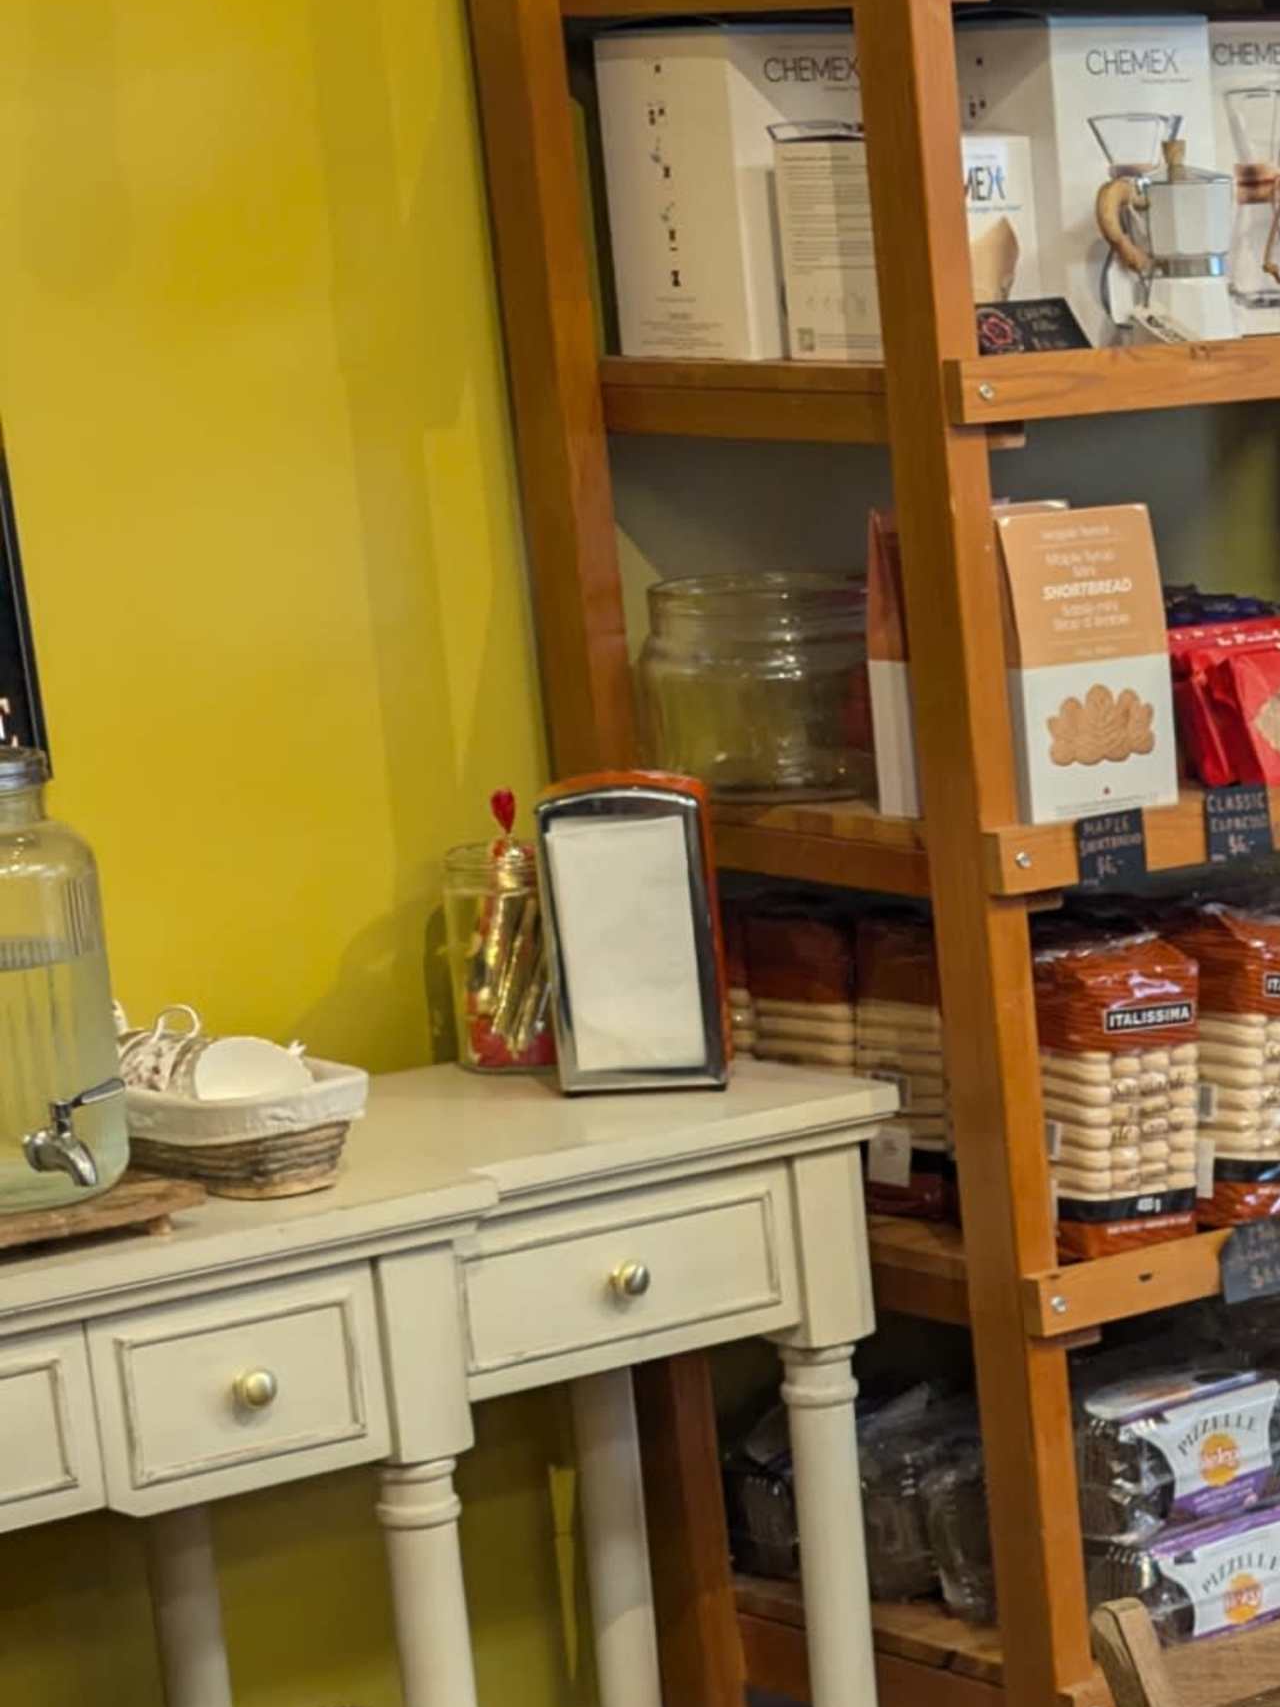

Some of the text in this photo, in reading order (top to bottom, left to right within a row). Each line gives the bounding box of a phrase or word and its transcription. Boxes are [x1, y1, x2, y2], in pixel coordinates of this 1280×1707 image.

[1086, 48, 1179, 75] CHEMEX
[1041, 577, 1133, 602] SHORTBREAD
[1108, 1006, 1191, 1029] ITALISSIMA
